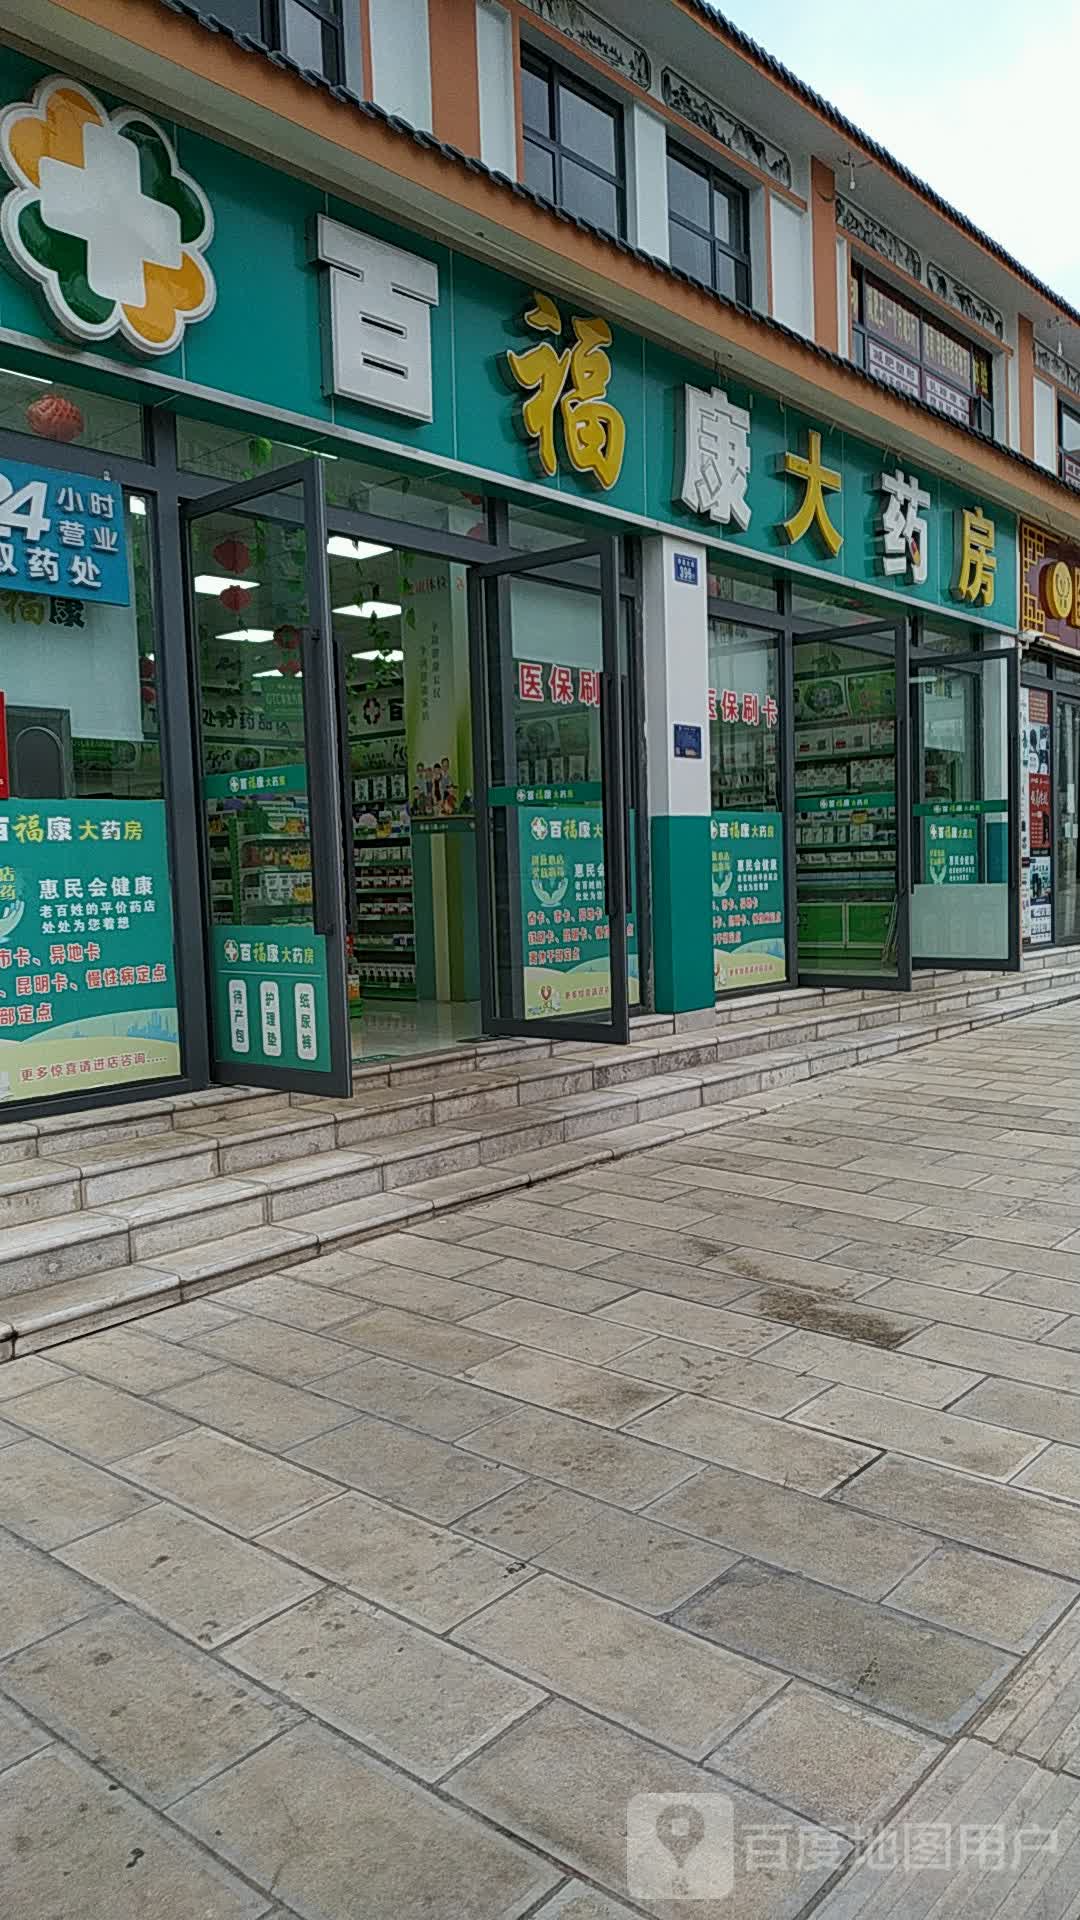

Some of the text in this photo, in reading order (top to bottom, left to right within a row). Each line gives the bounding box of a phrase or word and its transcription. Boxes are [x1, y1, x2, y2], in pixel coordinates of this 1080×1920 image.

[312, 213, 998, 608] 百福康大药房
[58, 487, 114, 518] 小时
[59, 520, 119, 552] 营业
[38, 876, 154, 900] 惠民会健康
[39, 900, 157, 919] 老百姓的平价药店
[41, 916, 131, 935] 处处为您着想
